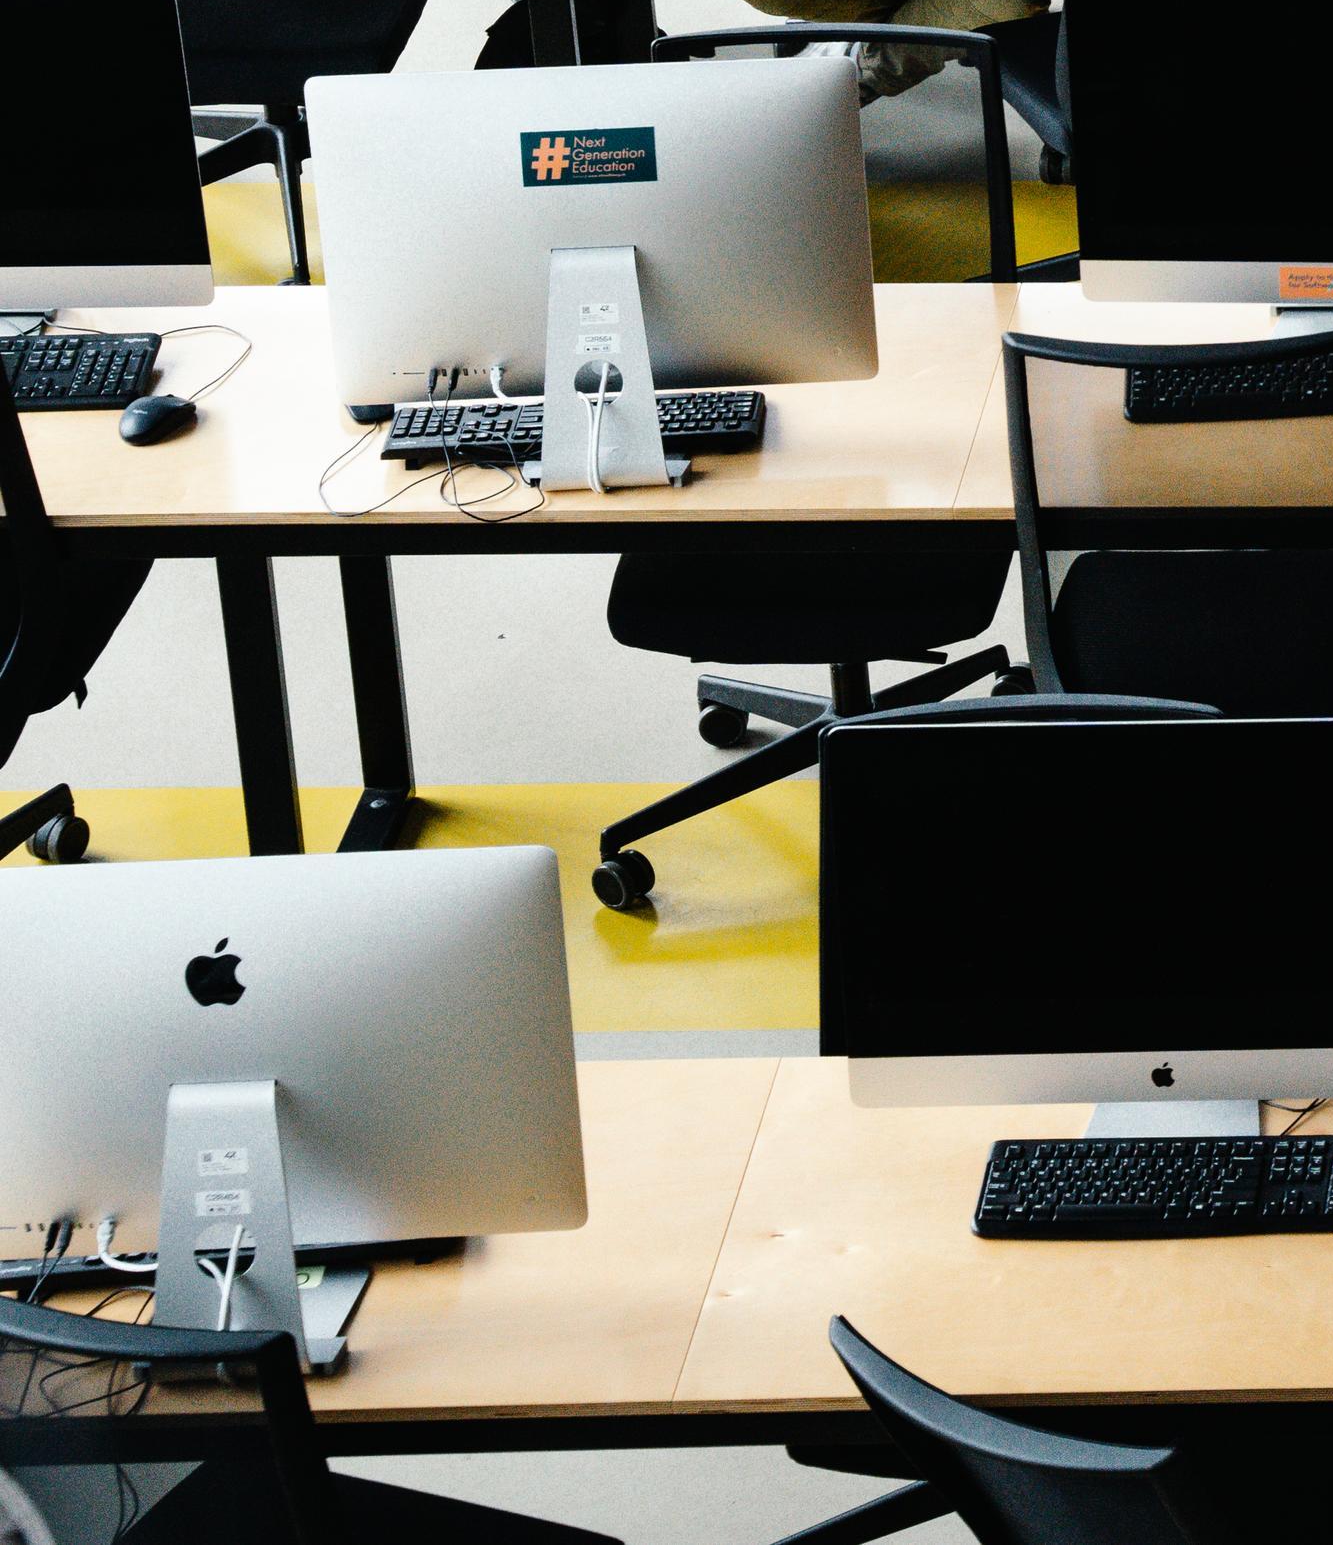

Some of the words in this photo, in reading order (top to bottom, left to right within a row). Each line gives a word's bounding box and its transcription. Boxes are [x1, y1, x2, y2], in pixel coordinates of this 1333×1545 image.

[573, 136, 606, 148] Next
[572, 148, 645, 161] Generation
[572, 161, 635, 173] Education
